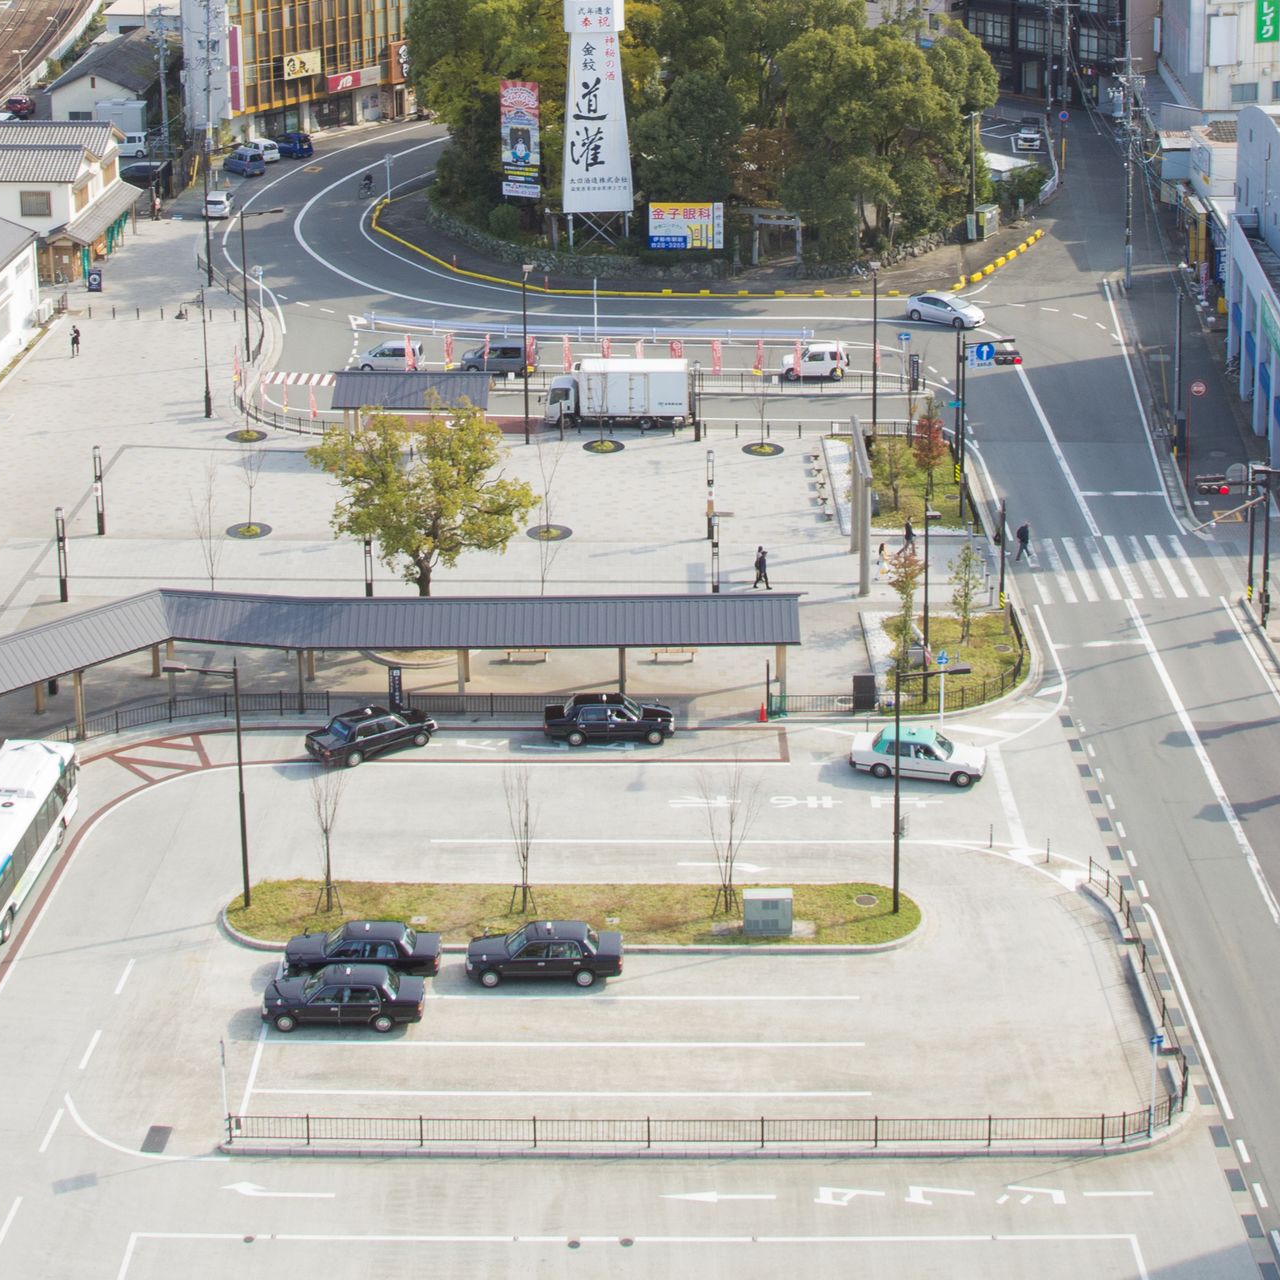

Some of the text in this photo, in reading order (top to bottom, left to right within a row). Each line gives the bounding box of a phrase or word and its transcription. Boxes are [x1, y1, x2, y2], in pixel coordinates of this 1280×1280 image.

[580, 16, 611, 28] 奉祝
[1261, 2, 1274, 38] レイク
[337, 75, 353, 89] JTB
[651, 207, 711, 220] 金子眼科
[813, 1184, 1154, 1207] タクシー
